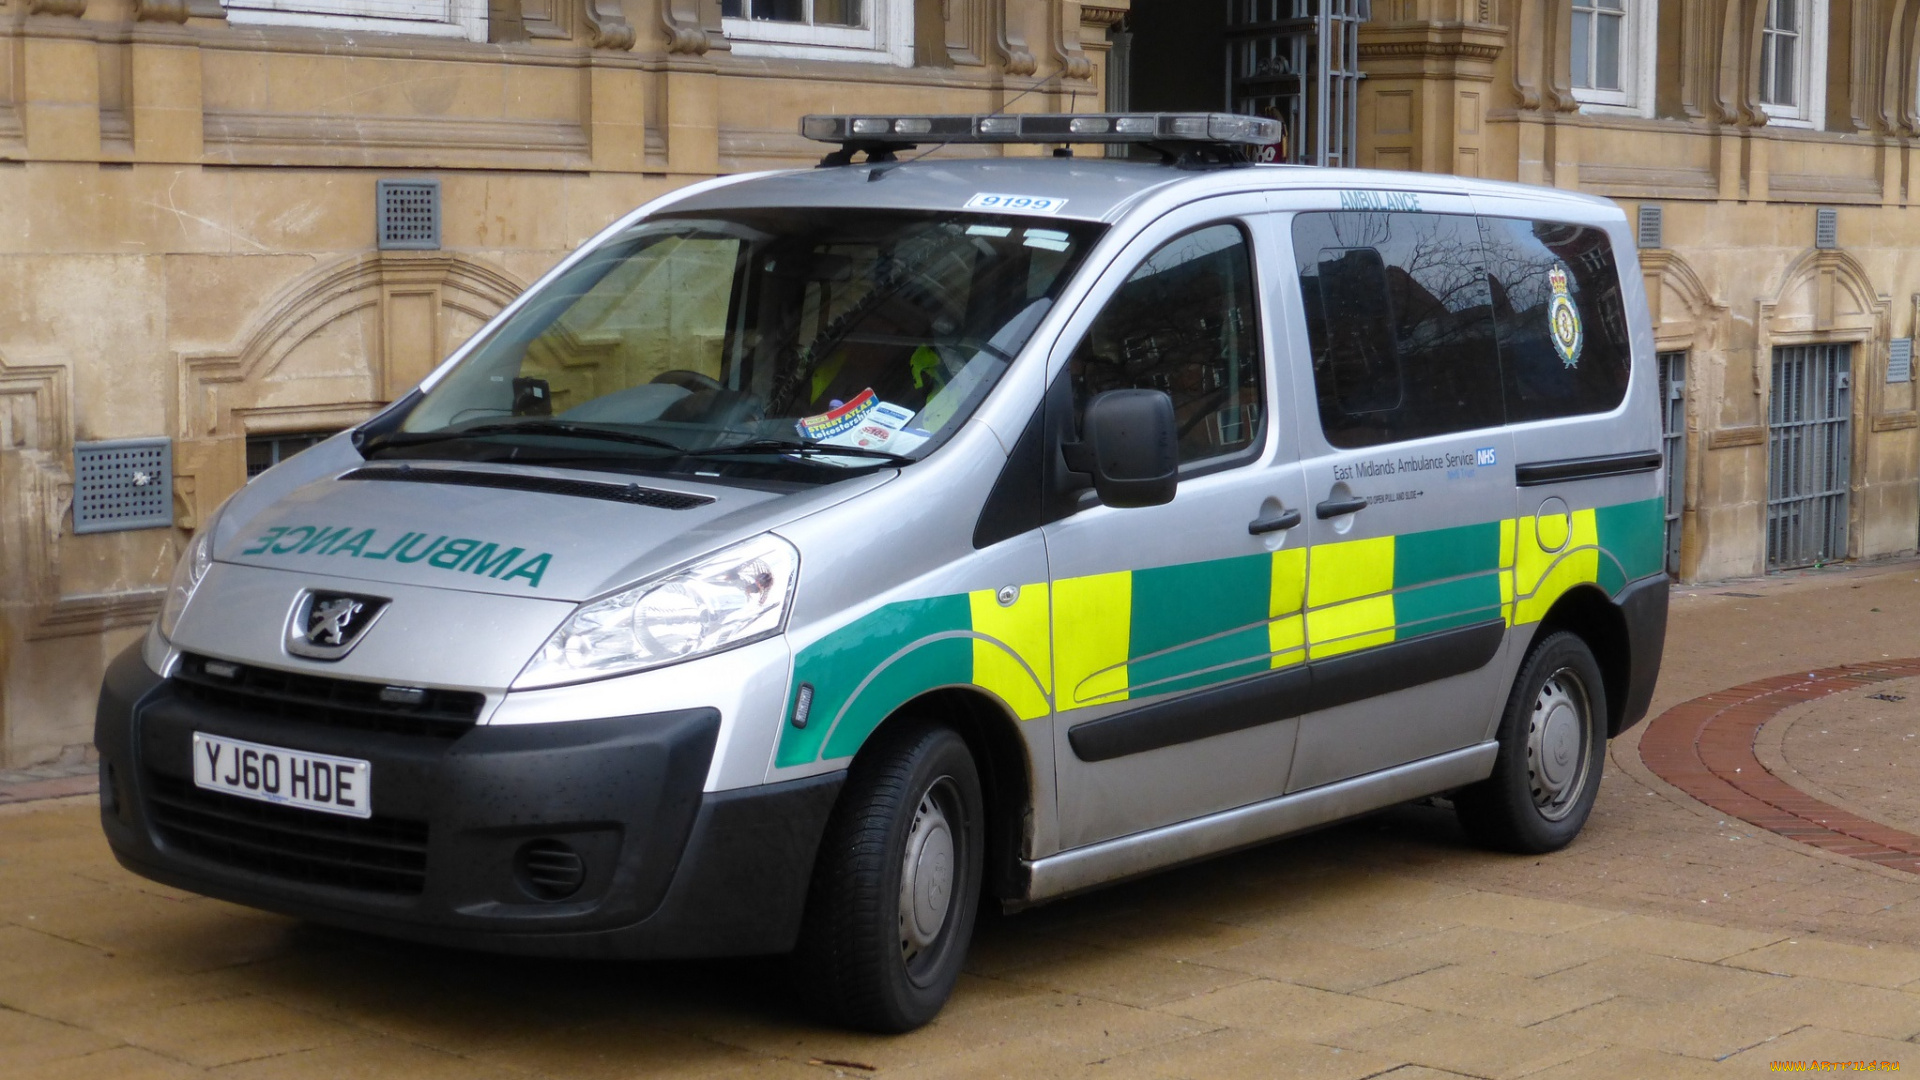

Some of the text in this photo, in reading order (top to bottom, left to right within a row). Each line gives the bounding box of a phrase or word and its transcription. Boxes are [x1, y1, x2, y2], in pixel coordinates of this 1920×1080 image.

[981, 196, 1051, 209] 9199
[1340, 190, 1422, 211] AMBULANCE
[808, 417, 842, 433] STREET
[845, 399, 873, 420] ATLAS
[1333, 449, 1495, 481] East Midlands Ambulance Service NHS
[1373, 494, 1385, 504] OPEN
[1385, 493, 1396, 502] PULL
[1405, 490, 1417, 500] SLIDE
[206, 741, 355, 807] YJ60 HDE
